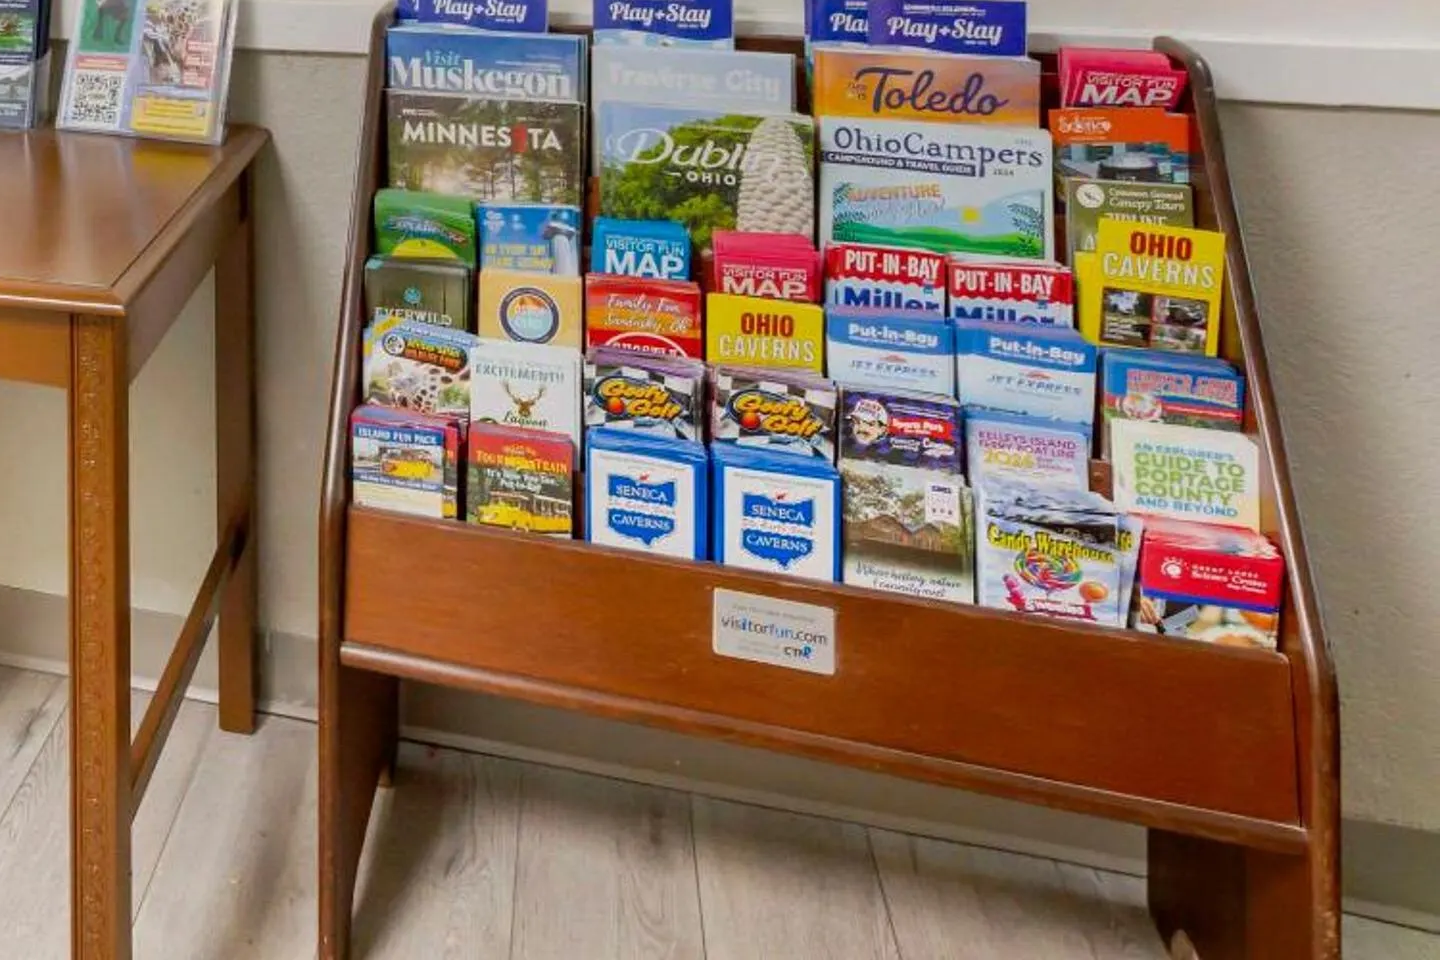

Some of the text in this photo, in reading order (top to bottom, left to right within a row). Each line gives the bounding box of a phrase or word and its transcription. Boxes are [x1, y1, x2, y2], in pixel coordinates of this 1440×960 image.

[424, 48, 461, 66] Visit
[390, 56, 573, 100] Muskegon
[1086, 73, 1179, 90] VISITOR FUN
[855, 66, 1010, 116] Toledo
[1079, 84, 1175, 107] MAP
[402, 120, 563, 152] MINNESTA
[833, 126, 1044, 177] OhioCampers
[685, 171, 737, 186] OHIO
[1109, 197, 1186, 212] Canopy Tours
[605, 238, 685, 257] VISITOR FUN
[1129, 230, 1193, 261] OHIO
[604, 248, 686, 280] MAP
[722, 266, 808, 283] VISITOR FUN
[844, 251, 941, 280] PUT-IN-BAY
[1102, 252, 1217, 289] CAVERNS
[722, 278, 808, 300] MAP
[954, 269, 1056, 296] PUT-IN-BAY
[606, 292, 652, 315] Family
[740, 311, 796, 338] OHIO
[718, 335, 815, 364] CAVERNS
[599, 377, 671, 406] Goofy
[626, 398, 683, 421] Golf
[735, 393, 810, 421] Goofy
[357, 427, 438, 445] ISLAND FUN PACK
[762, 414, 823, 438] Golf
[1029, 437, 1077, 450] ISLAND
[1133, 451, 1246, 478] GUIDE TO
[615, 483, 668, 501] SENECA
[1134, 466, 1246, 494] PORTAGE
[1134, 482, 1234, 506] COUNTY
[751, 503, 805, 522] SENECA
[1135, 496, 1239, 518] AND BEYOND
[611, 513, 671, 532] CAVERNS
[745, 534, 809, 553] CAVERNS
[987, 521, 1115, 565] Candy Warehouse
[721, 615, 829, 645] visitorfun.com
